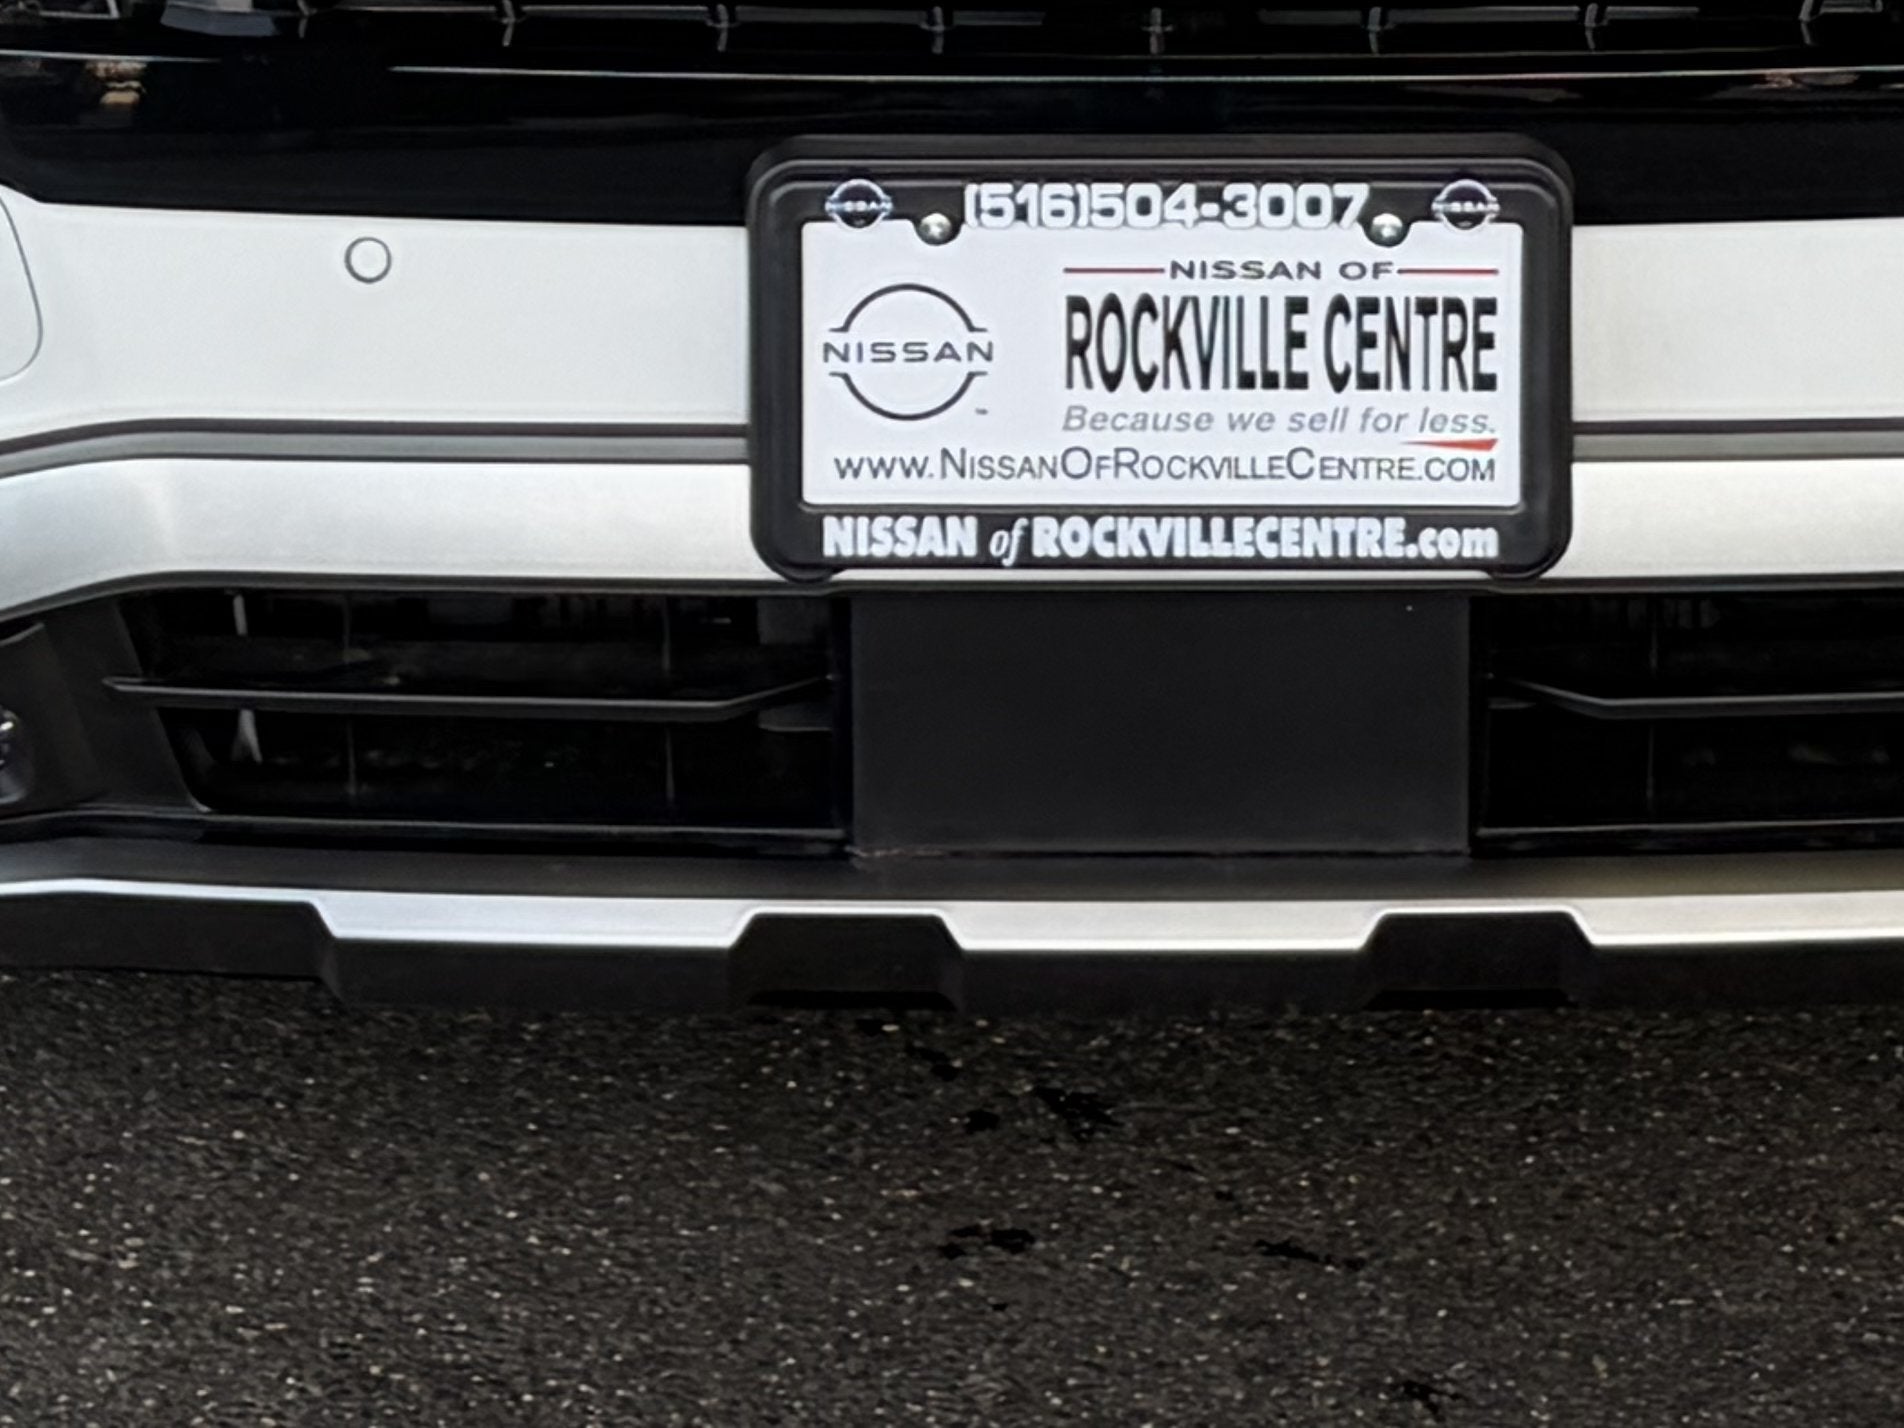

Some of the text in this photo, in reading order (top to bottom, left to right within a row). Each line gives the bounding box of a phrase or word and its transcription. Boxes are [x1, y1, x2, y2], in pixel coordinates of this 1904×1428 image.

[964, 182, 1369, 229] (516)504-3007
[1170, 260, 1394, 281] NISSAN OF
[822, 341, 993, 363] NISSAN
[1065, 293, 1498, 393] ROCKVILLE CENTRE
[1062, 405, 1497, 435] Because we sell for less.
[822, 515, 1500, 568] NISSAN of ROCKVILLECENTRE.com
